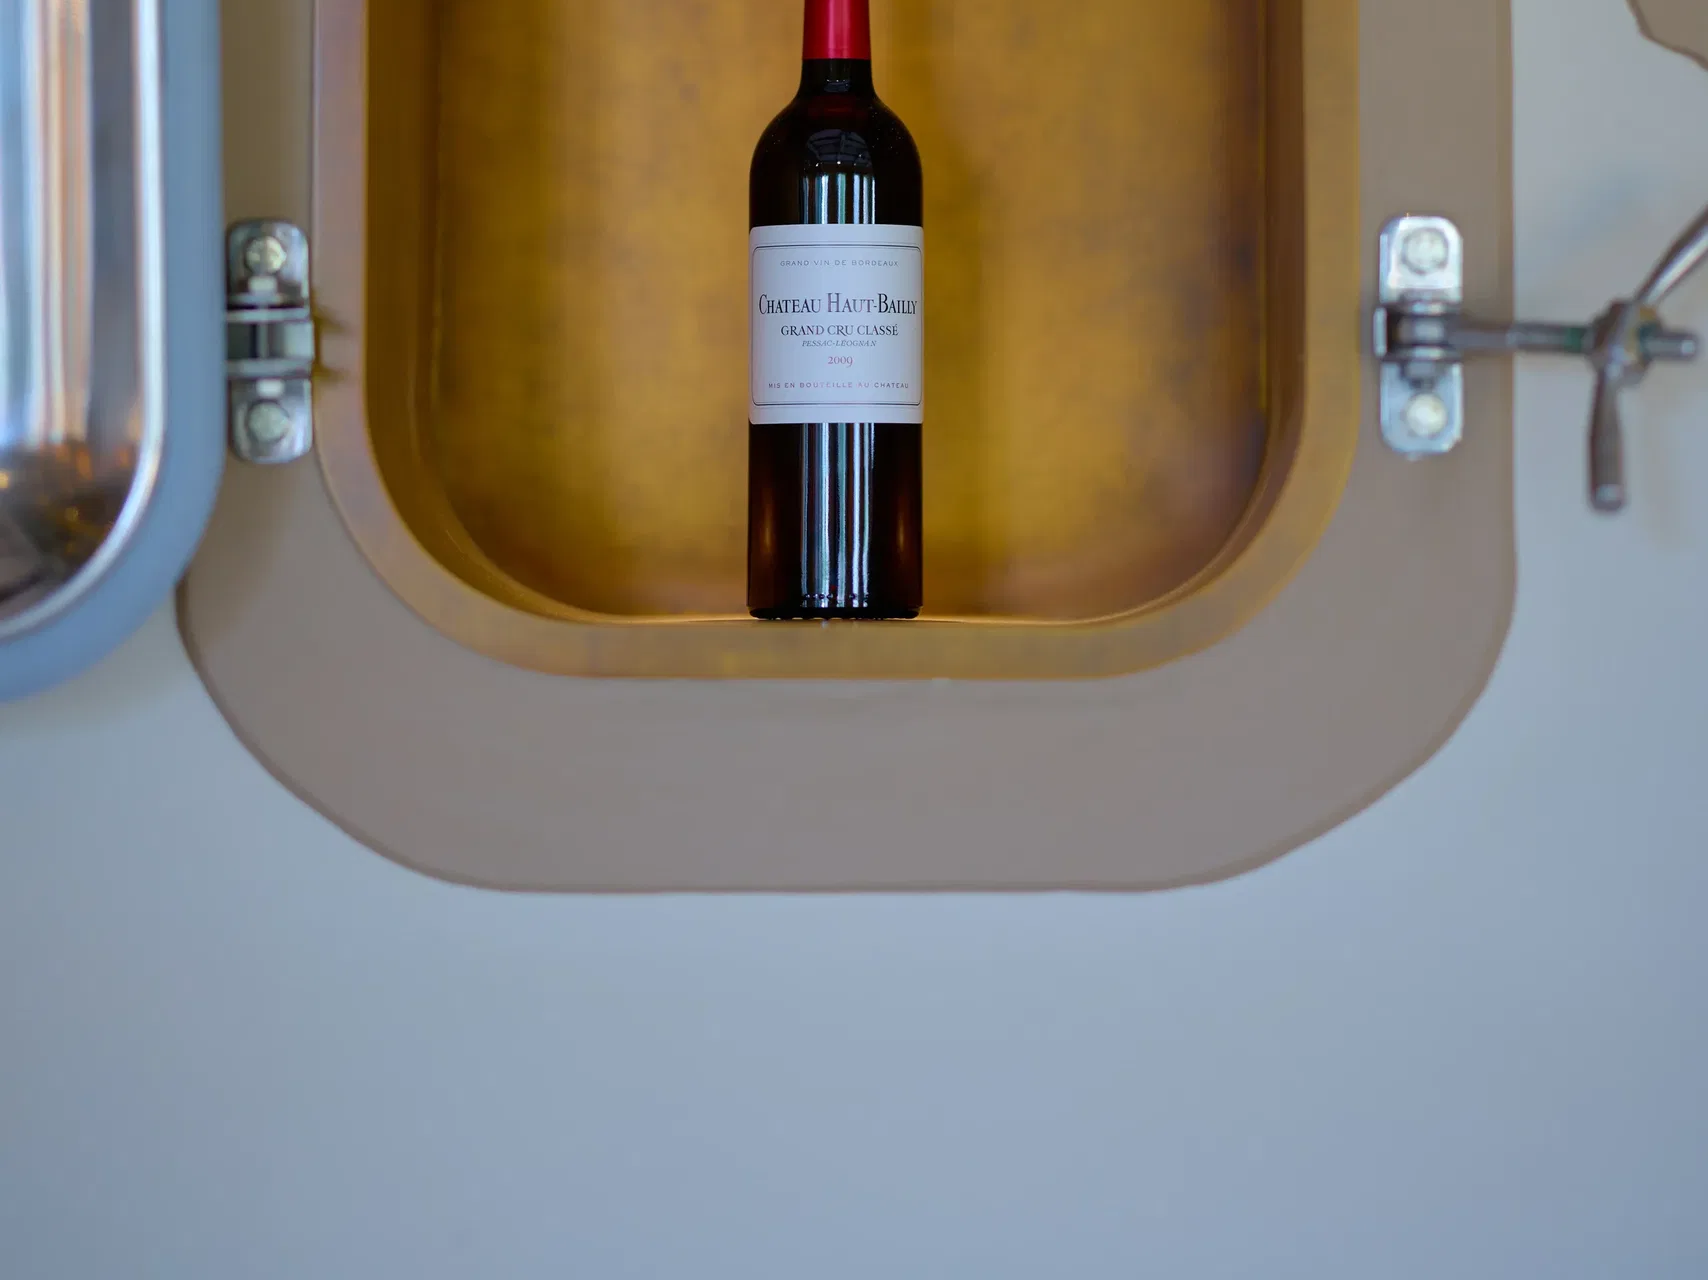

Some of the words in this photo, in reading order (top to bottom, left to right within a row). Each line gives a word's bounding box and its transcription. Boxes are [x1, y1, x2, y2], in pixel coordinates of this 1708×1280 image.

[780, 325, 824, 336] GRAND
[827, 324, 853, 336] CRU
[856, 323, 900, 336] CLASSÉ
[827, 356, 853, 368] 2009
[799, 381, 853, 389] BOUTEILLE
[857, 381, 870, 389] AU
